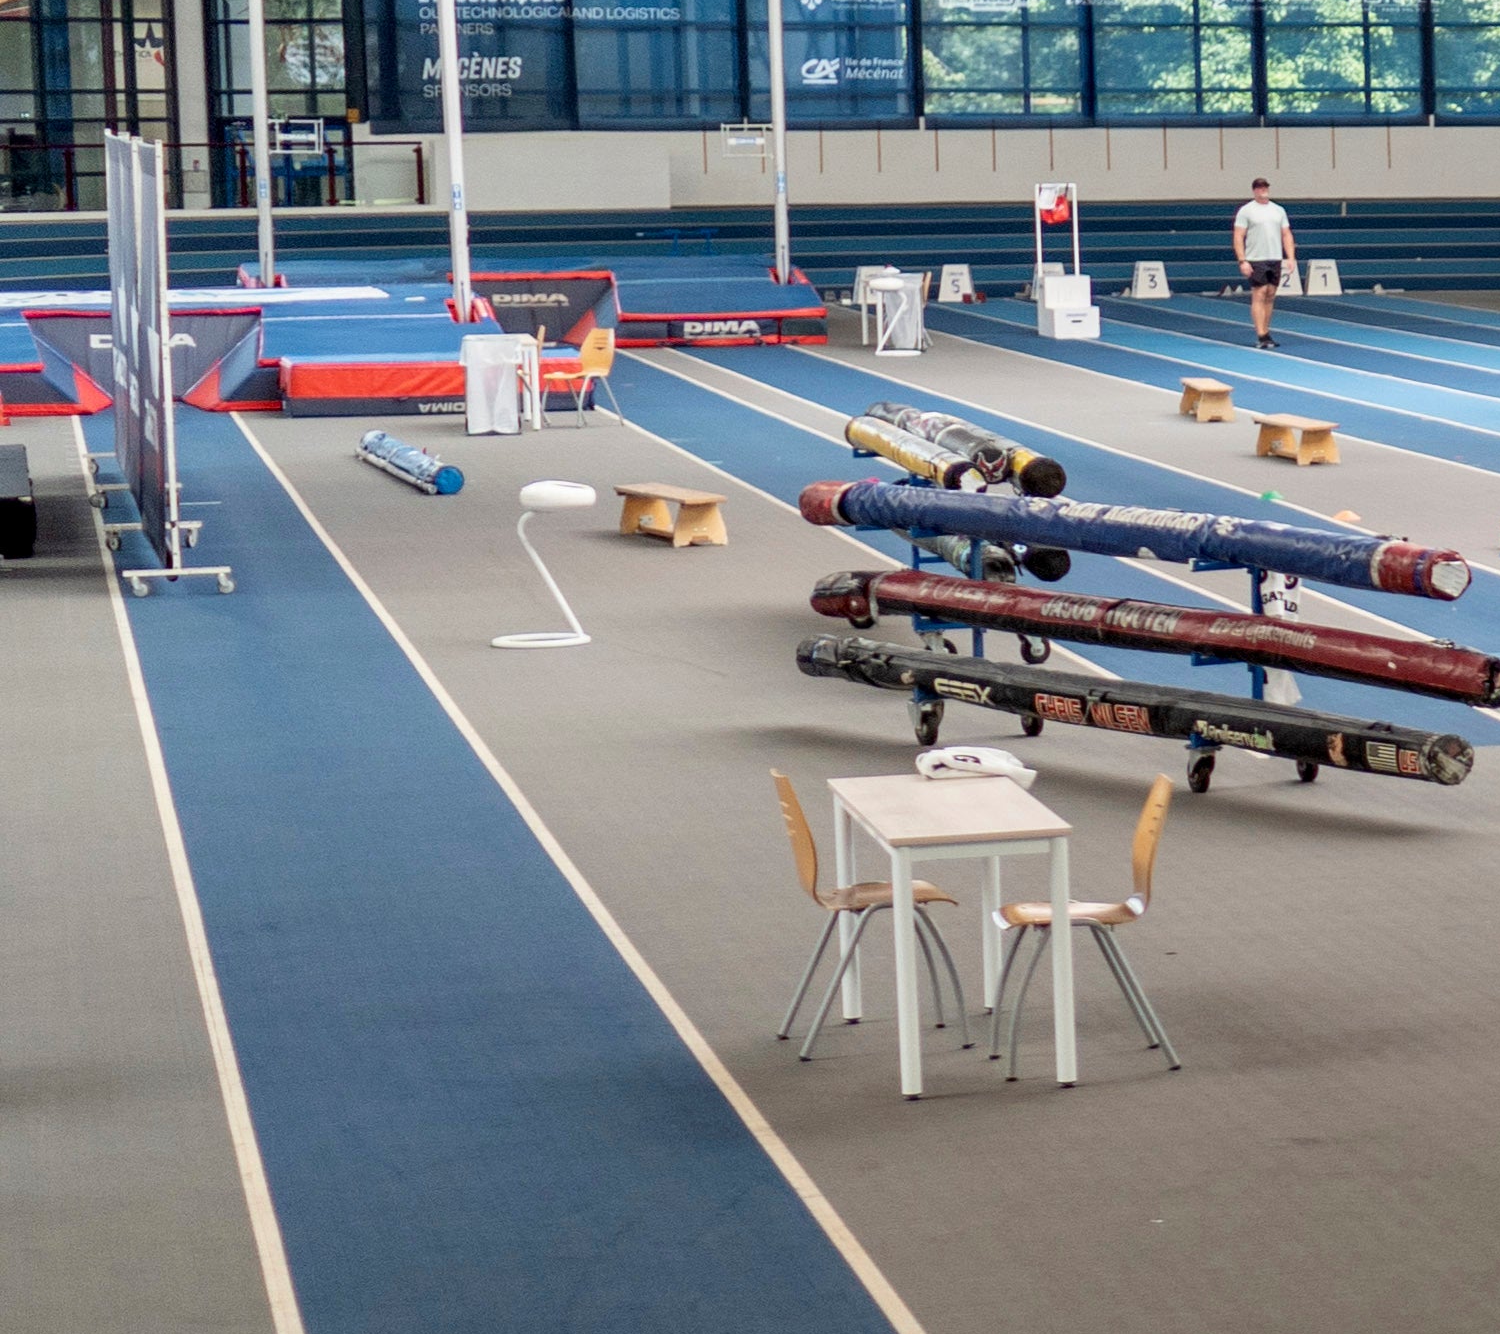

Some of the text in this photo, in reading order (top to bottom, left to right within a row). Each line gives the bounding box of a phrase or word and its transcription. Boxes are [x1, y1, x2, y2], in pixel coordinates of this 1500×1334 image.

[606, 7, 681, 20] LOGISTICS
[845, 65, 904, 80] Mécénat
[951, 278, 961, 293] 5
[1148, 273, 1158, 289] 3
[1281, 273, 1291, 288] 2
[1321, 273, 1328, 286] 1
[492, 293, 569, 307] DIMA
[683, 320, 760, 333] DIMA
